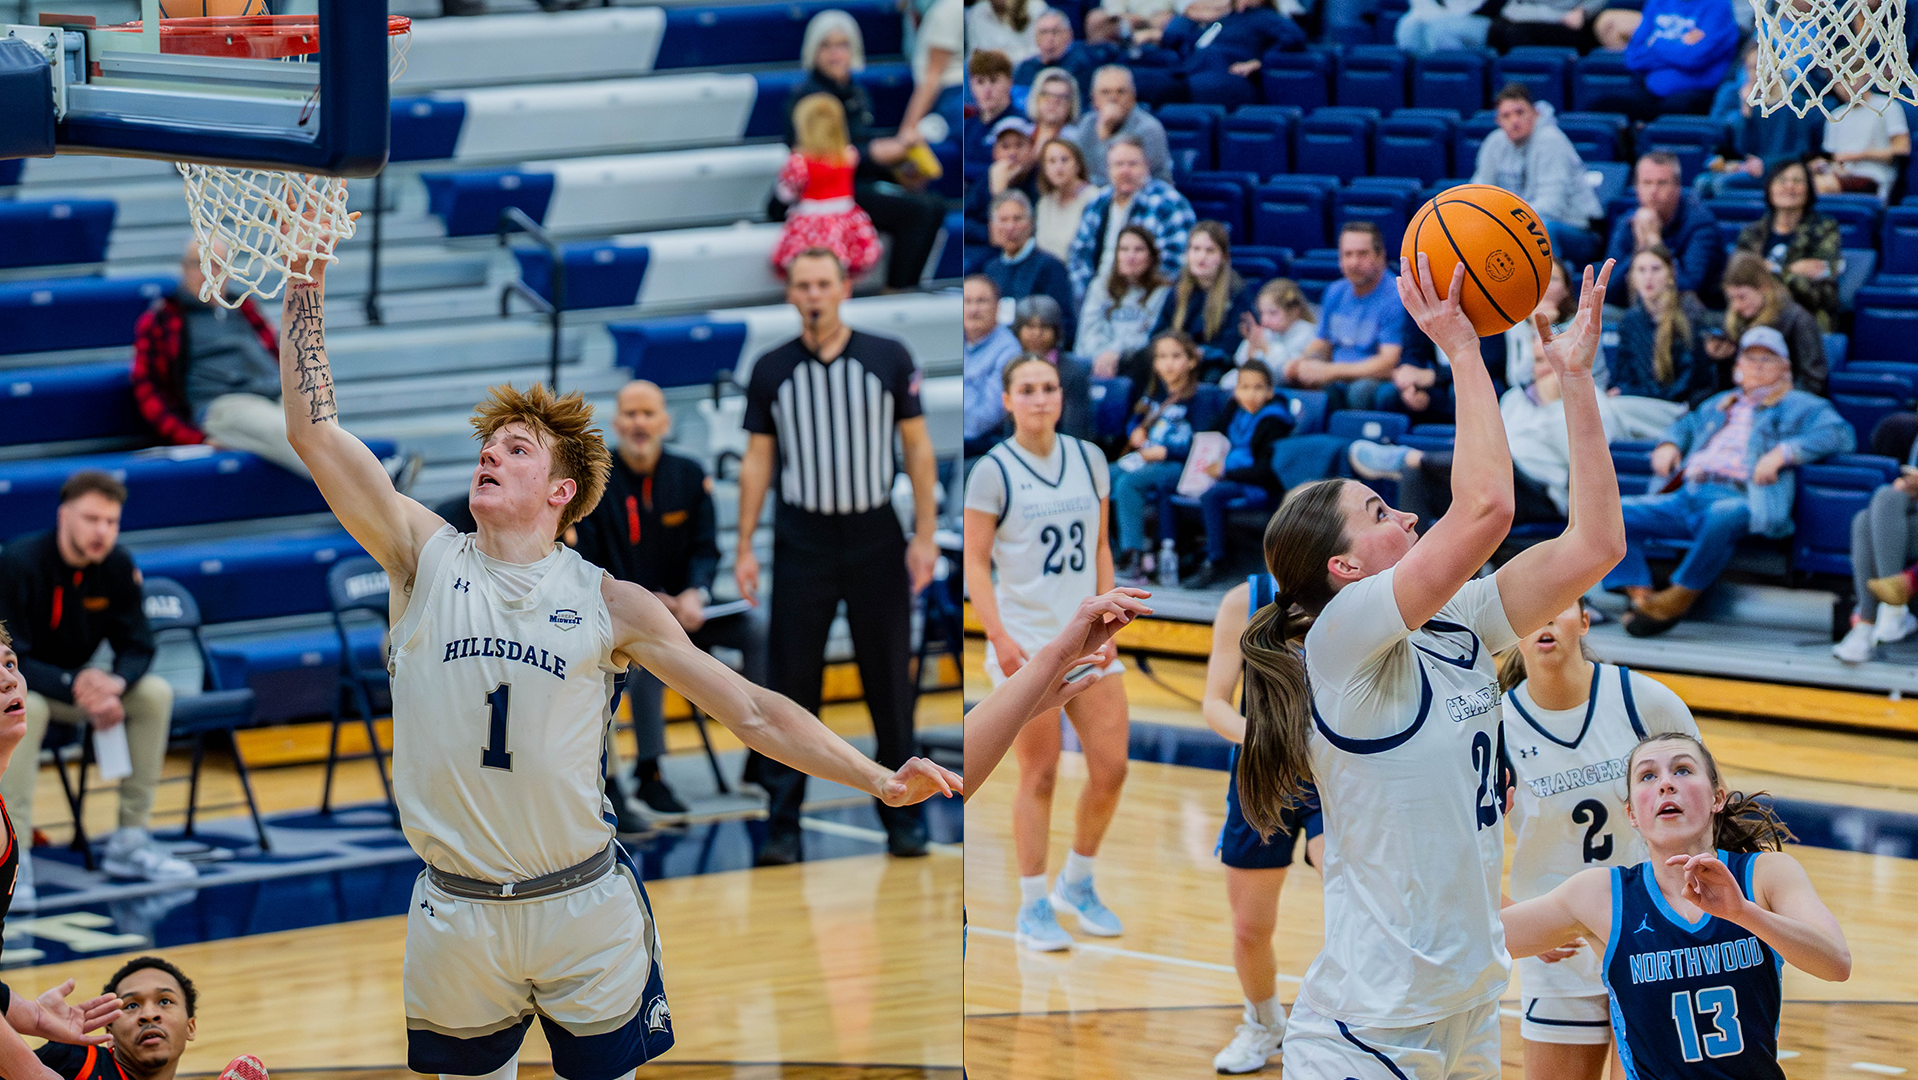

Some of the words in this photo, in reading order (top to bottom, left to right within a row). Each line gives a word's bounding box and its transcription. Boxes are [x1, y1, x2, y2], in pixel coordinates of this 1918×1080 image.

[1510, 208, 1550, 257] EVO
[1041, 521, 1085, 576] 23
[443, 637, 567, 681] HILLSDALE
[480, 681, 513, 772] 1
[1571, 798, 1613, 864] 2
[1629, 936, 1764, 984] NORTHWOOD
[1672, 985, 1745, 1063] 13
